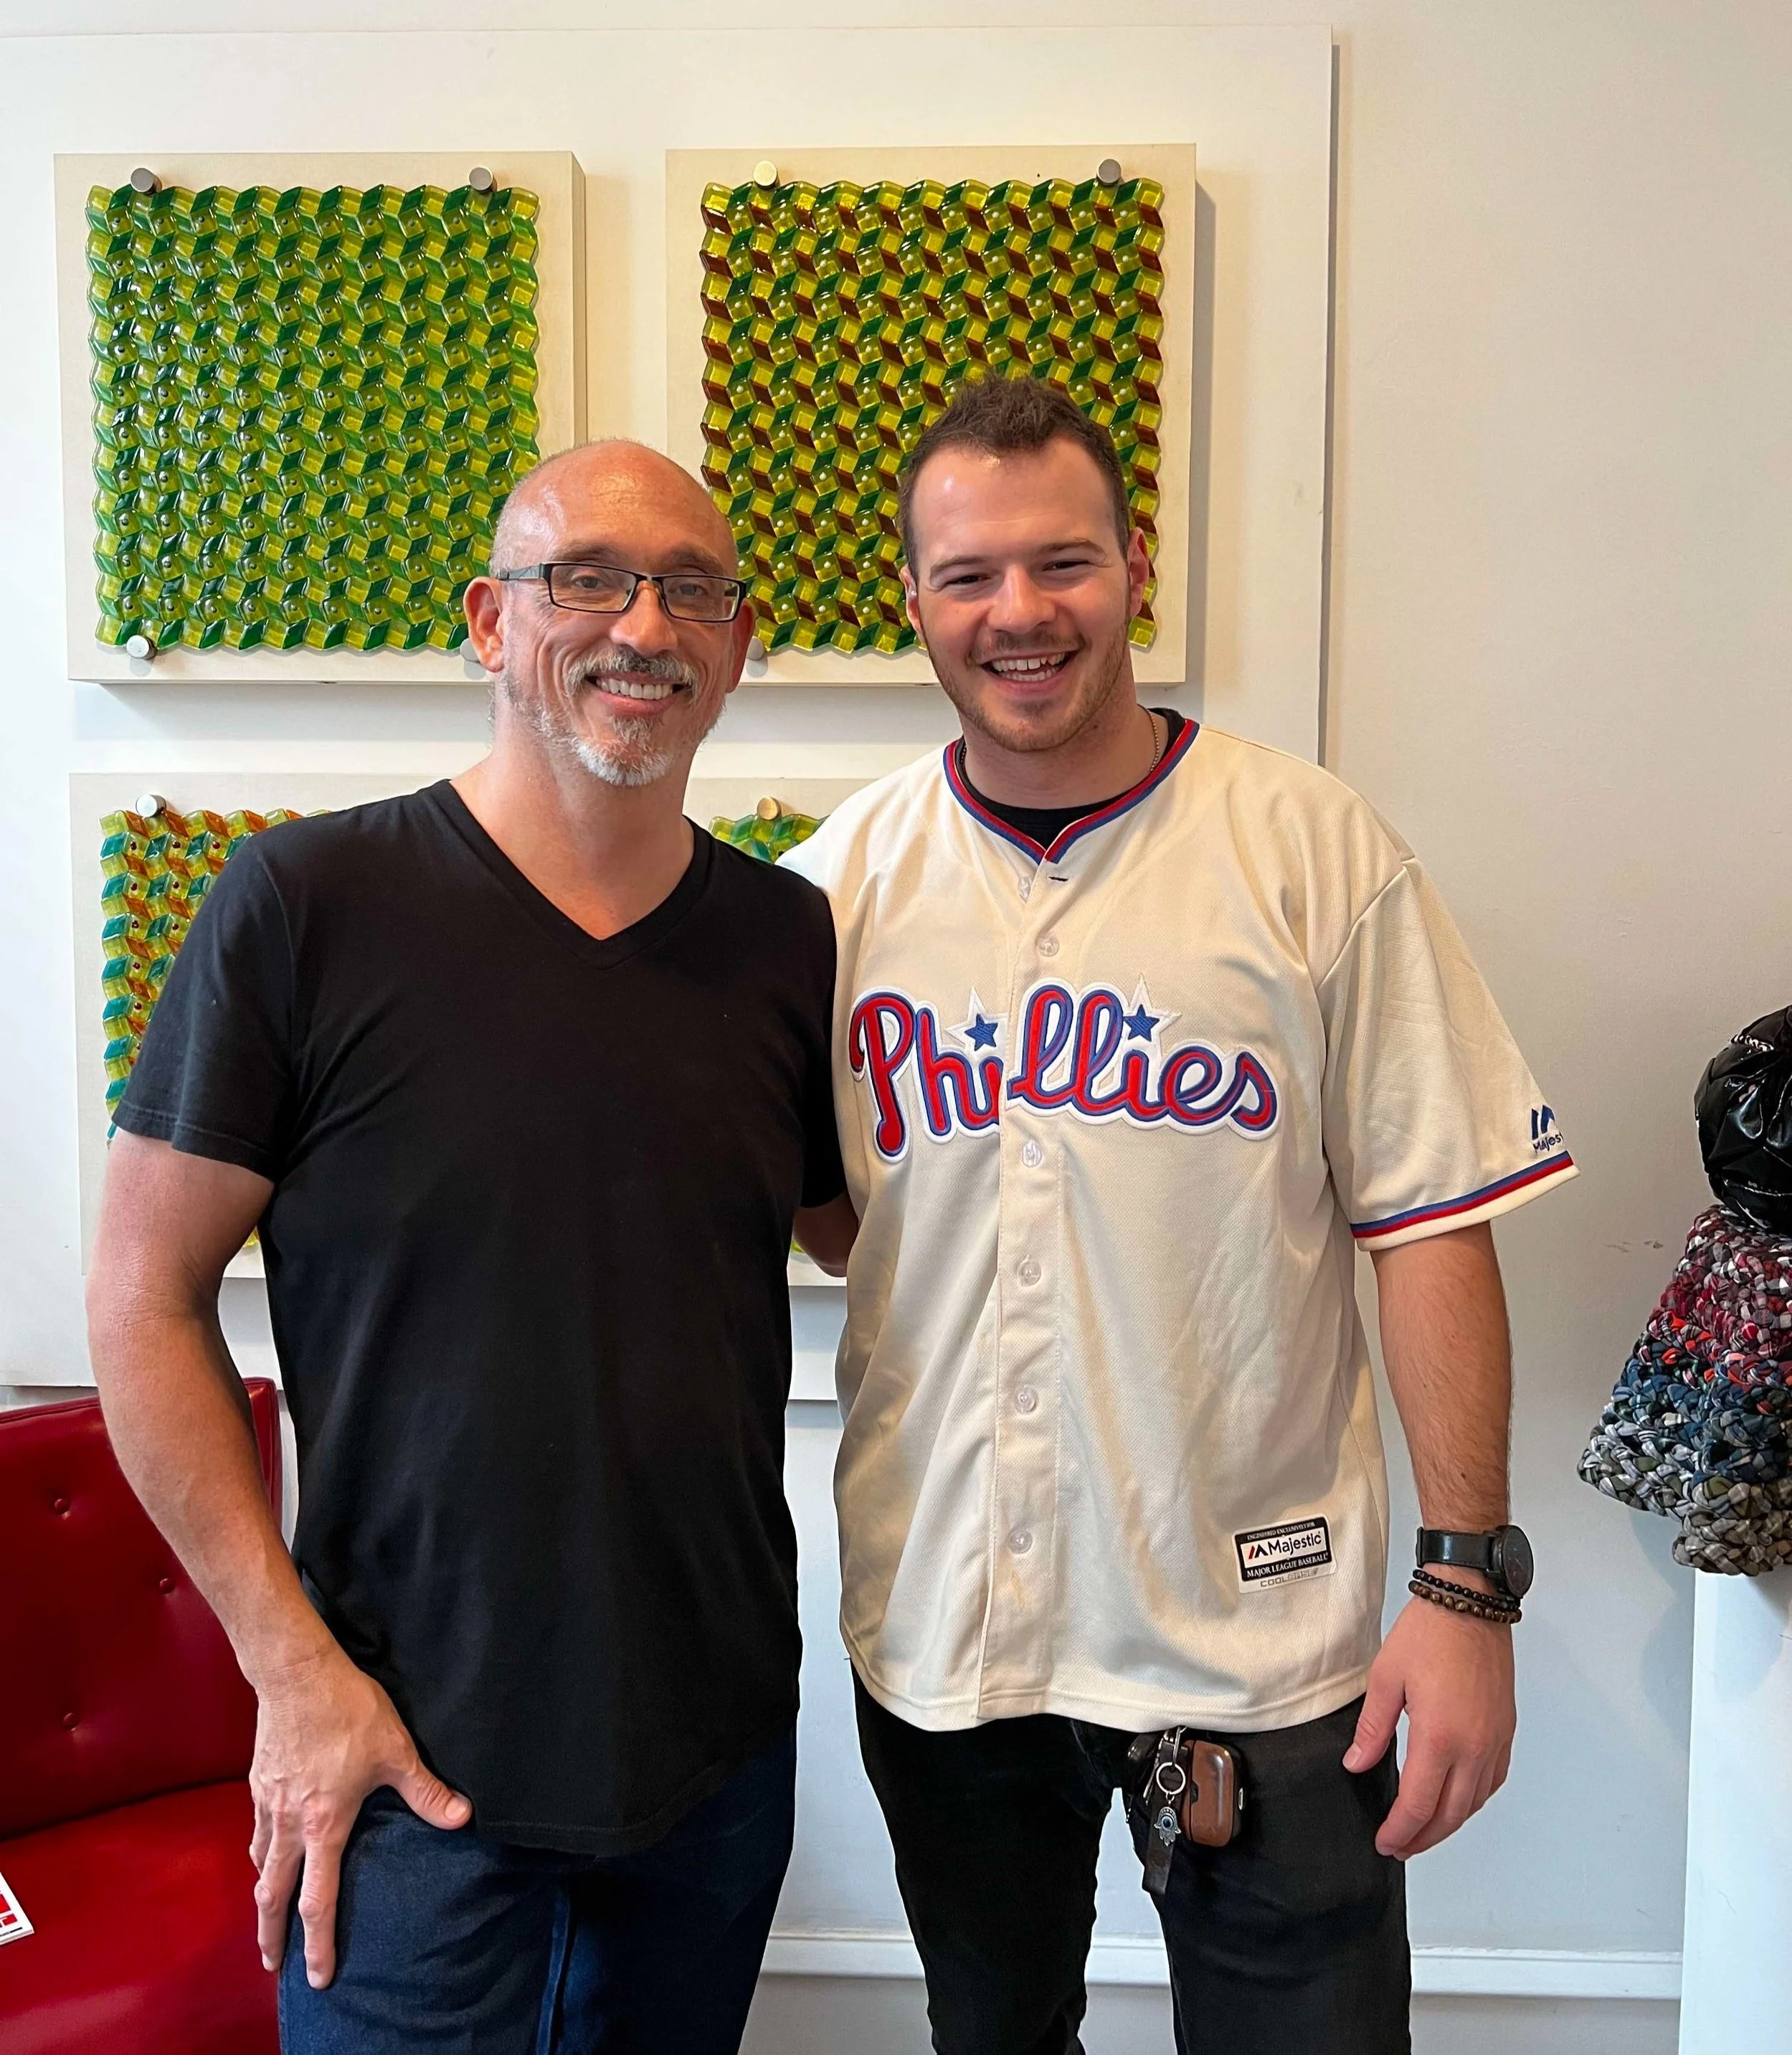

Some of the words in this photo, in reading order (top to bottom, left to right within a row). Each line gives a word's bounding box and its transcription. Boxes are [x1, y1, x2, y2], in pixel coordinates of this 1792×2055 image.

[850, 983, 1279, 1157] Phillies
[1268, 1533, 1322, 1555] Majestic
[1247, 1566, 1271, 1578] MAJOR
[1271, 1560, 1297, 1572] LEAGUE
